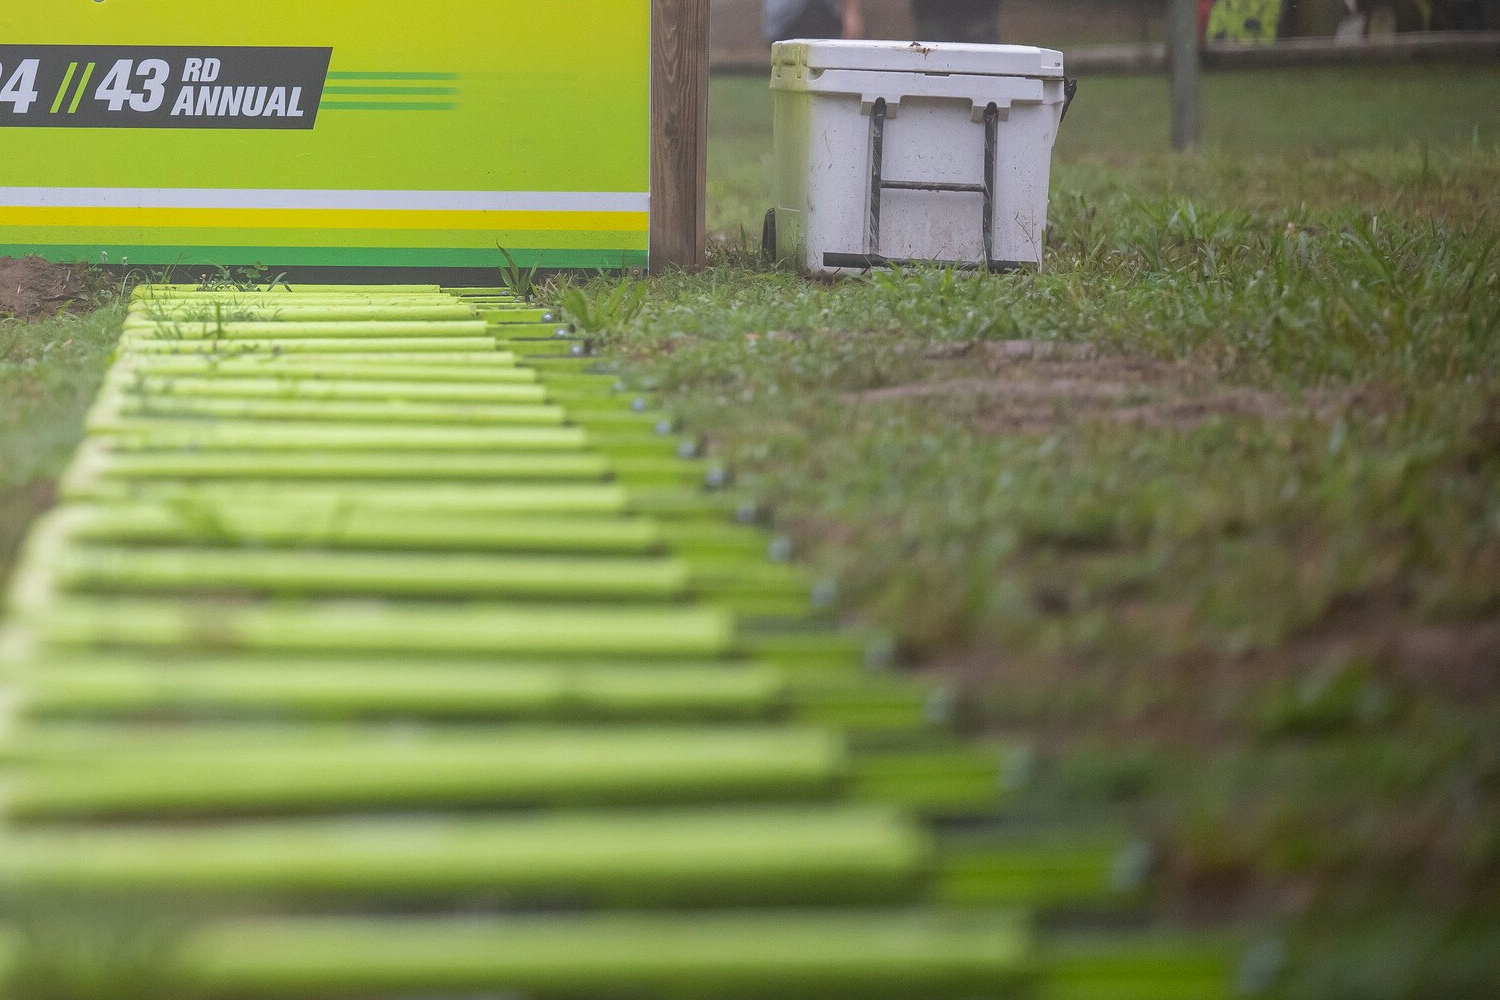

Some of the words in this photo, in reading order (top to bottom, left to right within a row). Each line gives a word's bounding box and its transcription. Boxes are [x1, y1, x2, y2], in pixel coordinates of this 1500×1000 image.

[94, 58, 170, 112] 43
[181, 57, 222, 82] RD
[170, 86, 305, 117] ANNUAL
